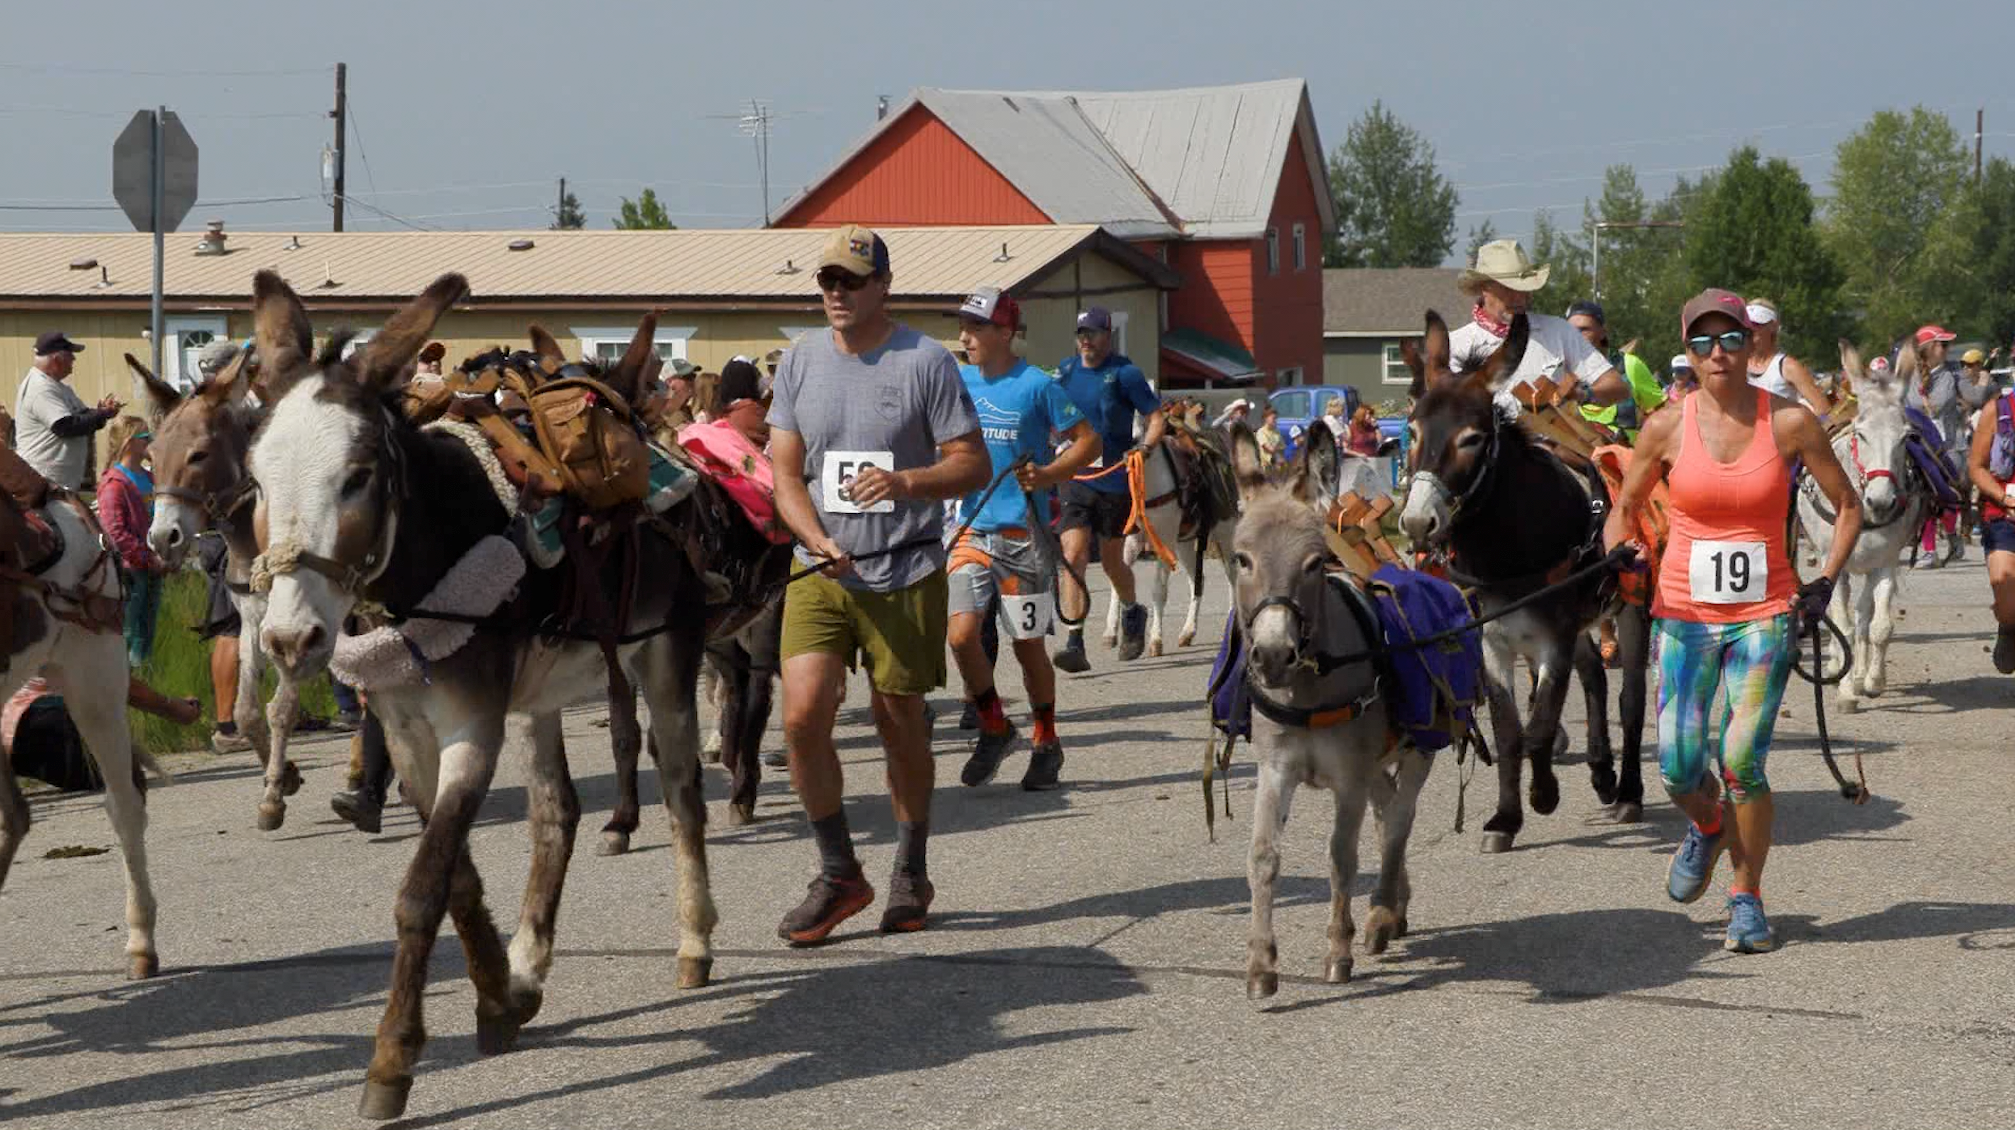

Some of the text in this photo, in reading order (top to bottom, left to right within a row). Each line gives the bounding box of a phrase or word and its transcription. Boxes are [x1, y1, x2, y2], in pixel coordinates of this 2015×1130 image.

[981, 427, 1018, 440] ITUDE
[1711, 551, 1750, 593] 19
[1022, 602, 1036, 631] 3
